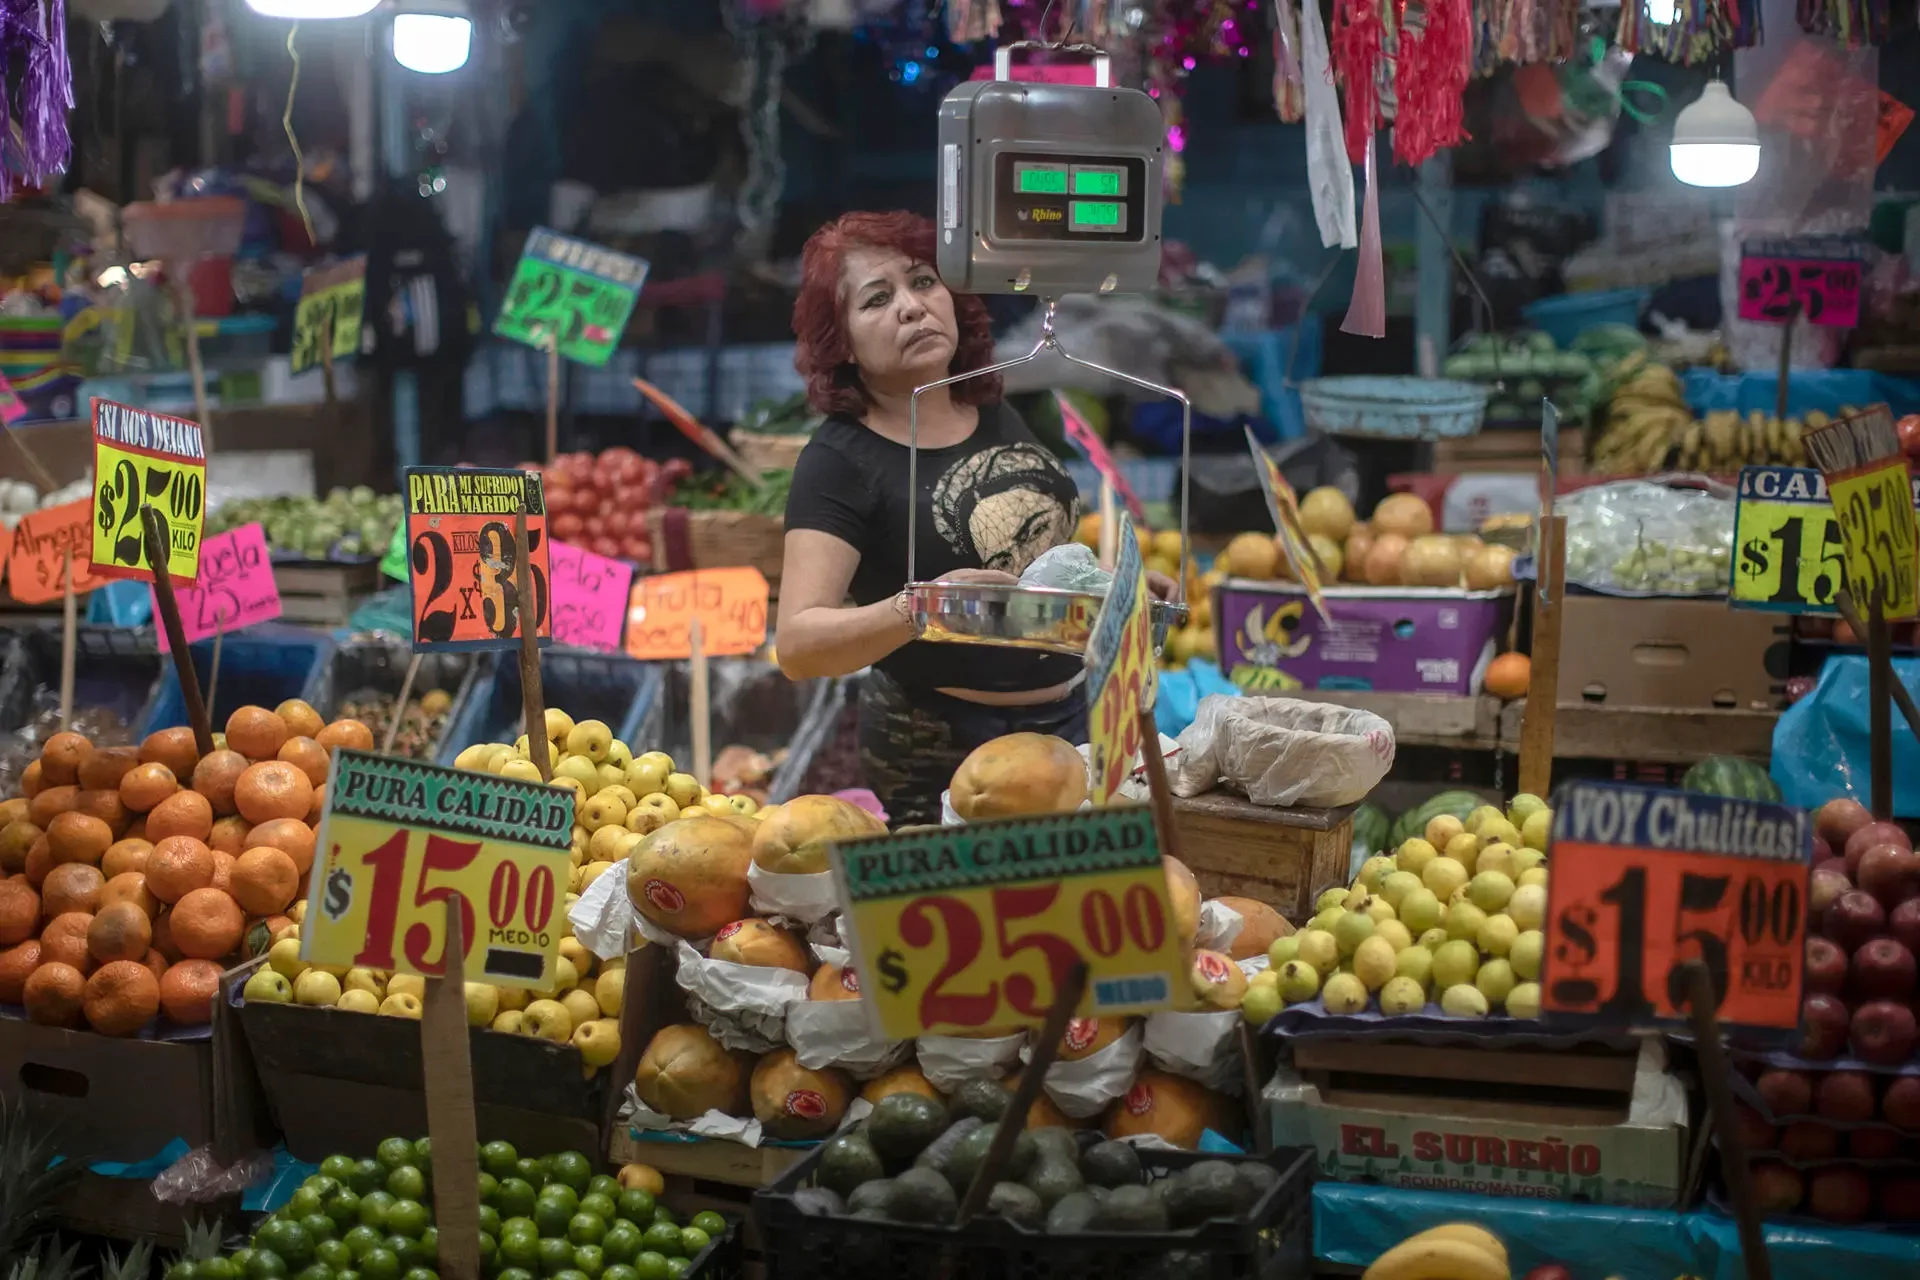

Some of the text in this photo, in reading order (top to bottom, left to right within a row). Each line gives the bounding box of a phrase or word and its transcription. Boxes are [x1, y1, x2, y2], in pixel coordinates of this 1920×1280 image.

[1032, 208, 1062, 222] Rhino
[120, 408, 148, 448] NOS
[409, 474, 460, 514] PARA
[460, 475, 472, 495] MI
[172, 529, 195, 551] KILO
[452, 534, 480, 551] KILOS
[345, 770, 567, 832] PURA CALIDAD
[1649, 796, 1807, 861] Chulitas!
[858, 822, 1148, 881] PURA CALIDAD
[489, 929, 550, 948] MEDIO
[1341, 1123, 1600, 1177] EL SUREÑO
[1399, 1174, 1559, 1200] ROUND TOMATOES
